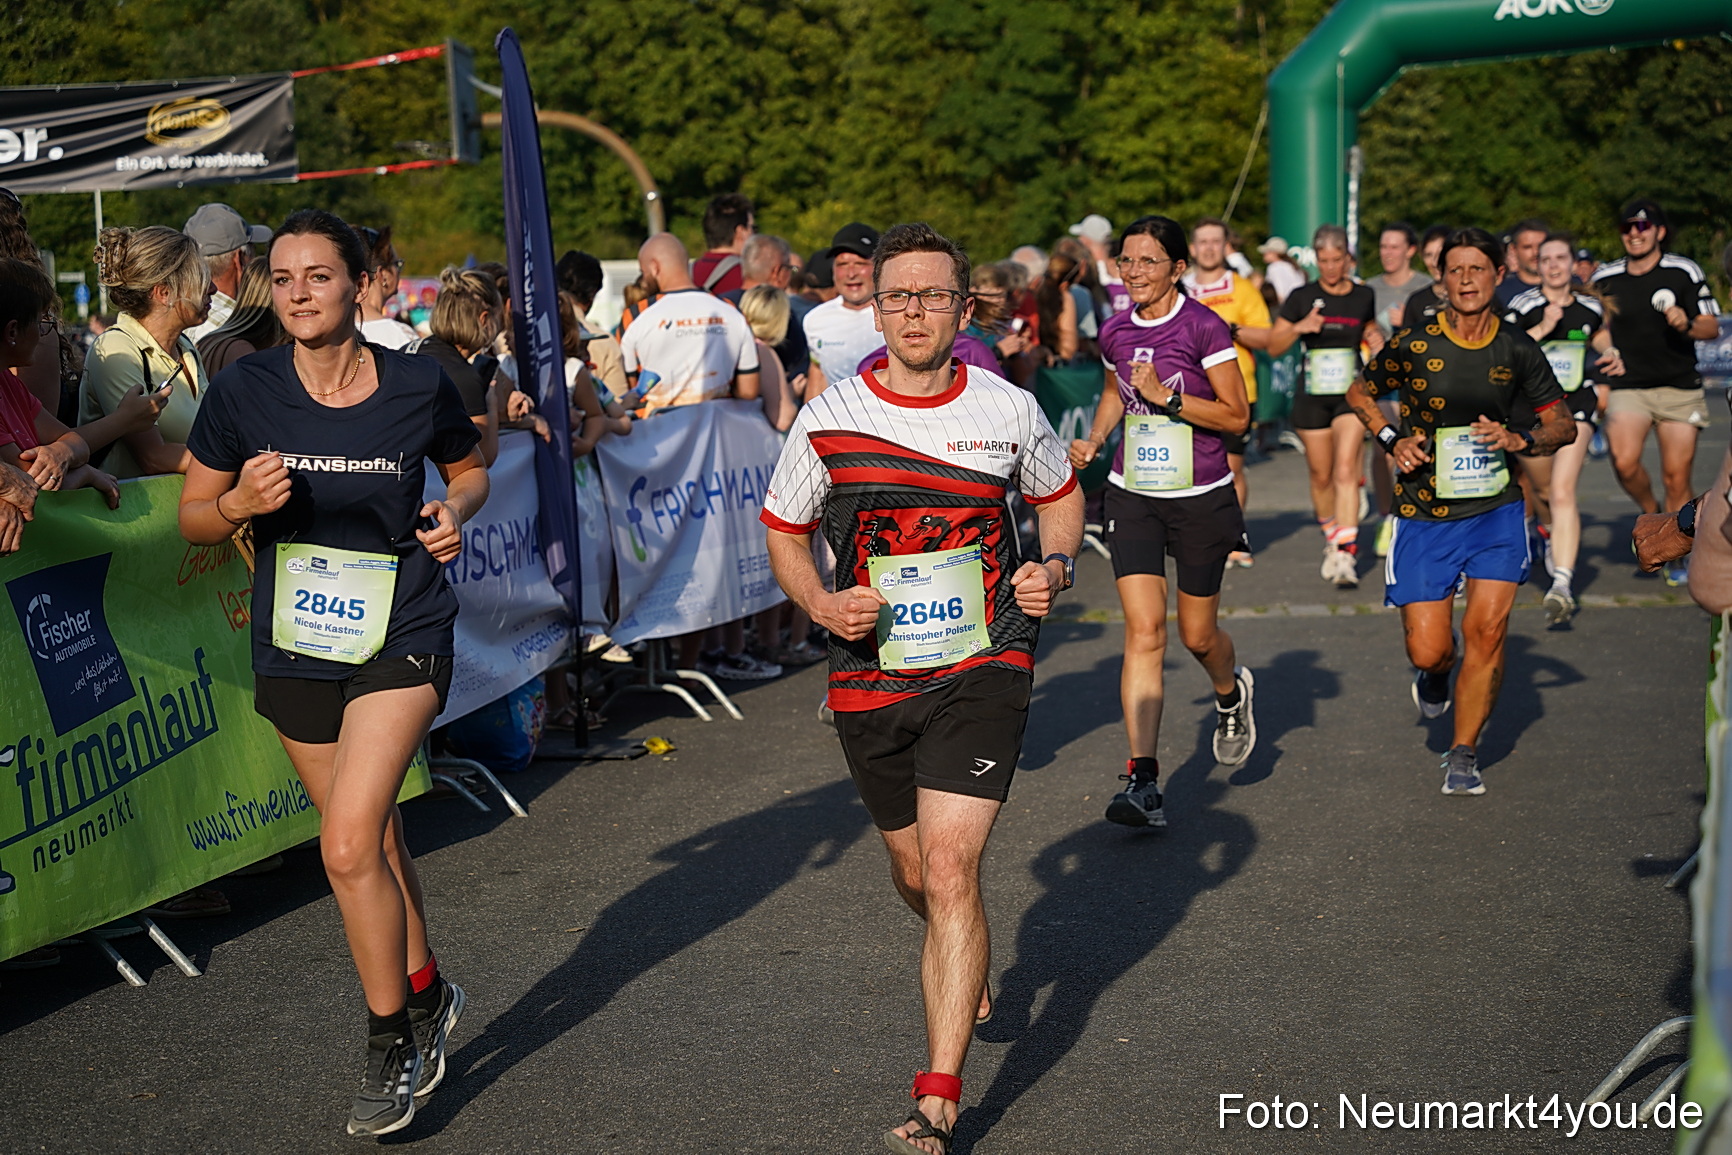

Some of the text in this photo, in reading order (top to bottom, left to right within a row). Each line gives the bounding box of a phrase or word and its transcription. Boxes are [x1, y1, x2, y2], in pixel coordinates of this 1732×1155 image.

[0, 128, 64, 164] er.
[115, 152, 269, 171] Ein Ort, der verbindet.
[947, 440, 1010, 452] NEUMARKT
[1137, 447, 1169, 461] 993
[279, 456, 397, 472] RANSpofix
[1453, 455, 1488, 470] 2107
[305, 566, 340, 577] Firmenlauf
[897, 575, 932, 585] Firmenlauf
[294, 589, 365, 620] 2845
[893, 597, 964, 625] 2646
[38, 608, 92, 650] Fischer
[294, 616, 323, 630] Nicole
[325, 623, 365, 637] Kastner
[887, 631, 944, 643] Christopher
[945, 623, 977, 639] Polster
[54, 634, 97, 664] AUTOMOBILE
[16, 647, 219, 834] firmenlauf
[33, 791, 134, 872] neumarkt
